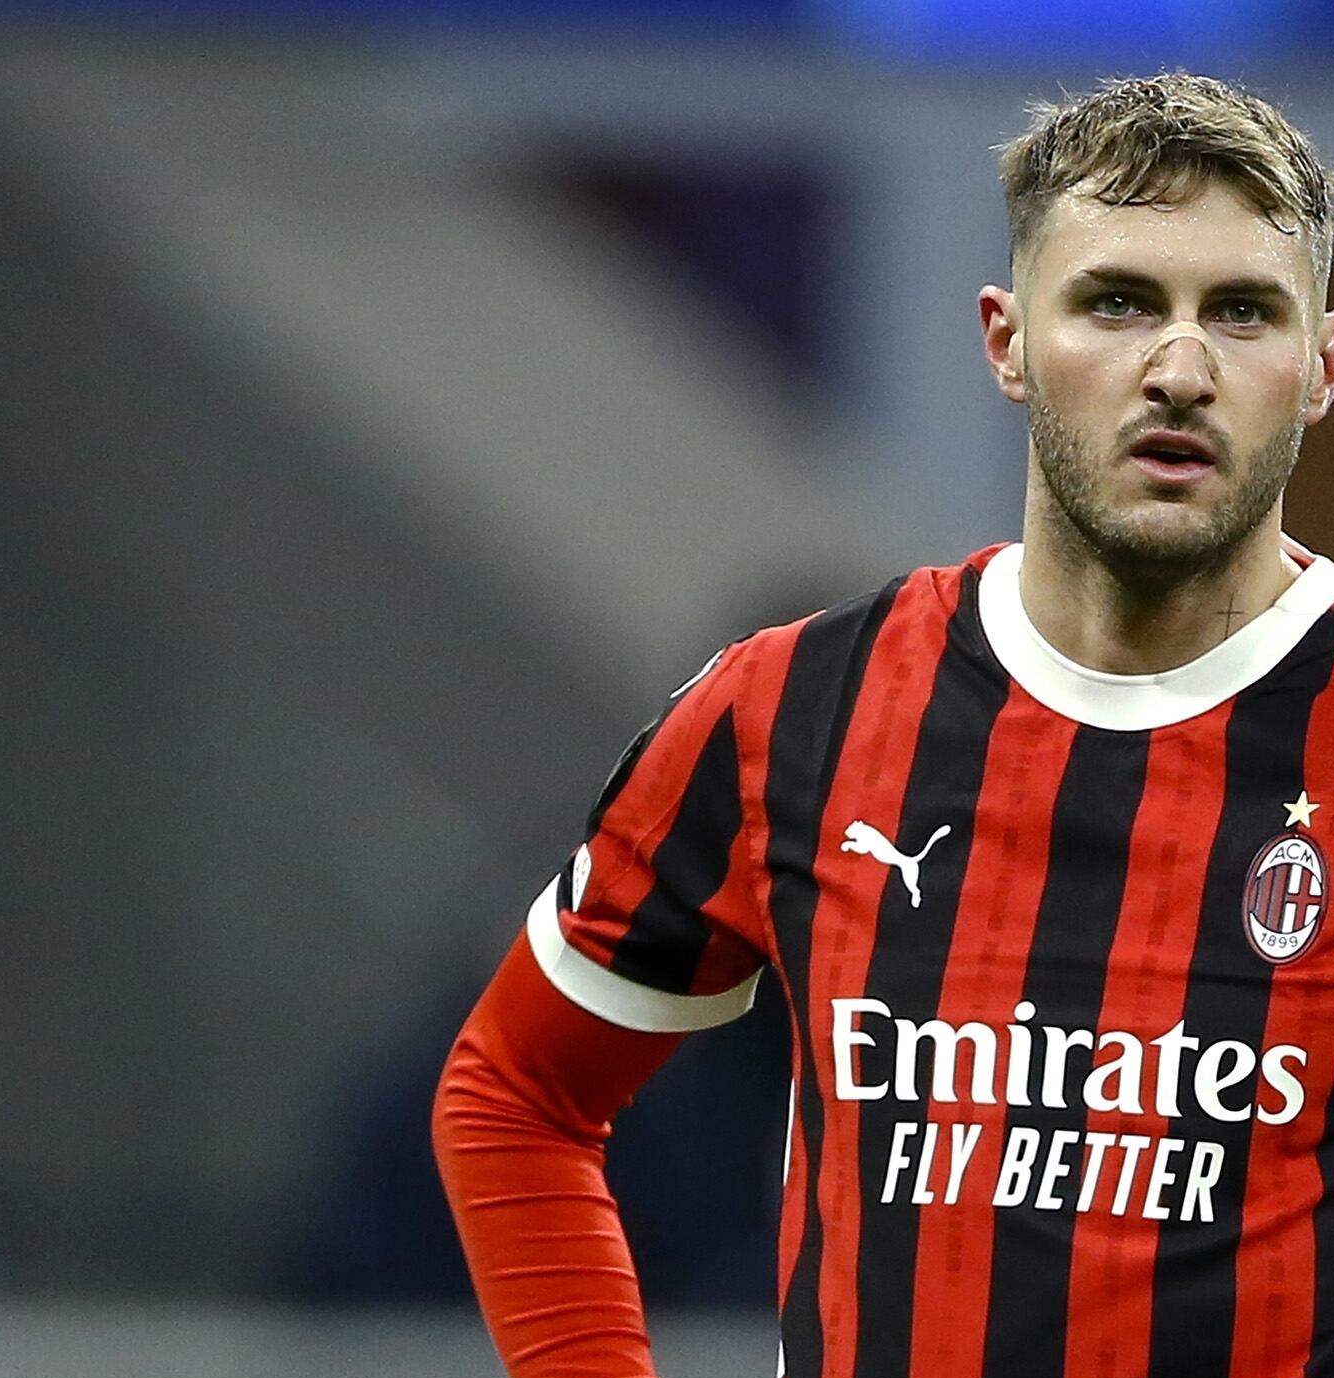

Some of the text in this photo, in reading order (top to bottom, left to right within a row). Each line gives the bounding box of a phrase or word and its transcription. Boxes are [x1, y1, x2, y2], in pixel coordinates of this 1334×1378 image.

[1270, 843, 1314, 867] ACM
[1260, 933, 1298, 948] 1899
[831, 998, 1308, 1125] Emirates
[880, 1121, 1225, 1222] FLY BETTER
